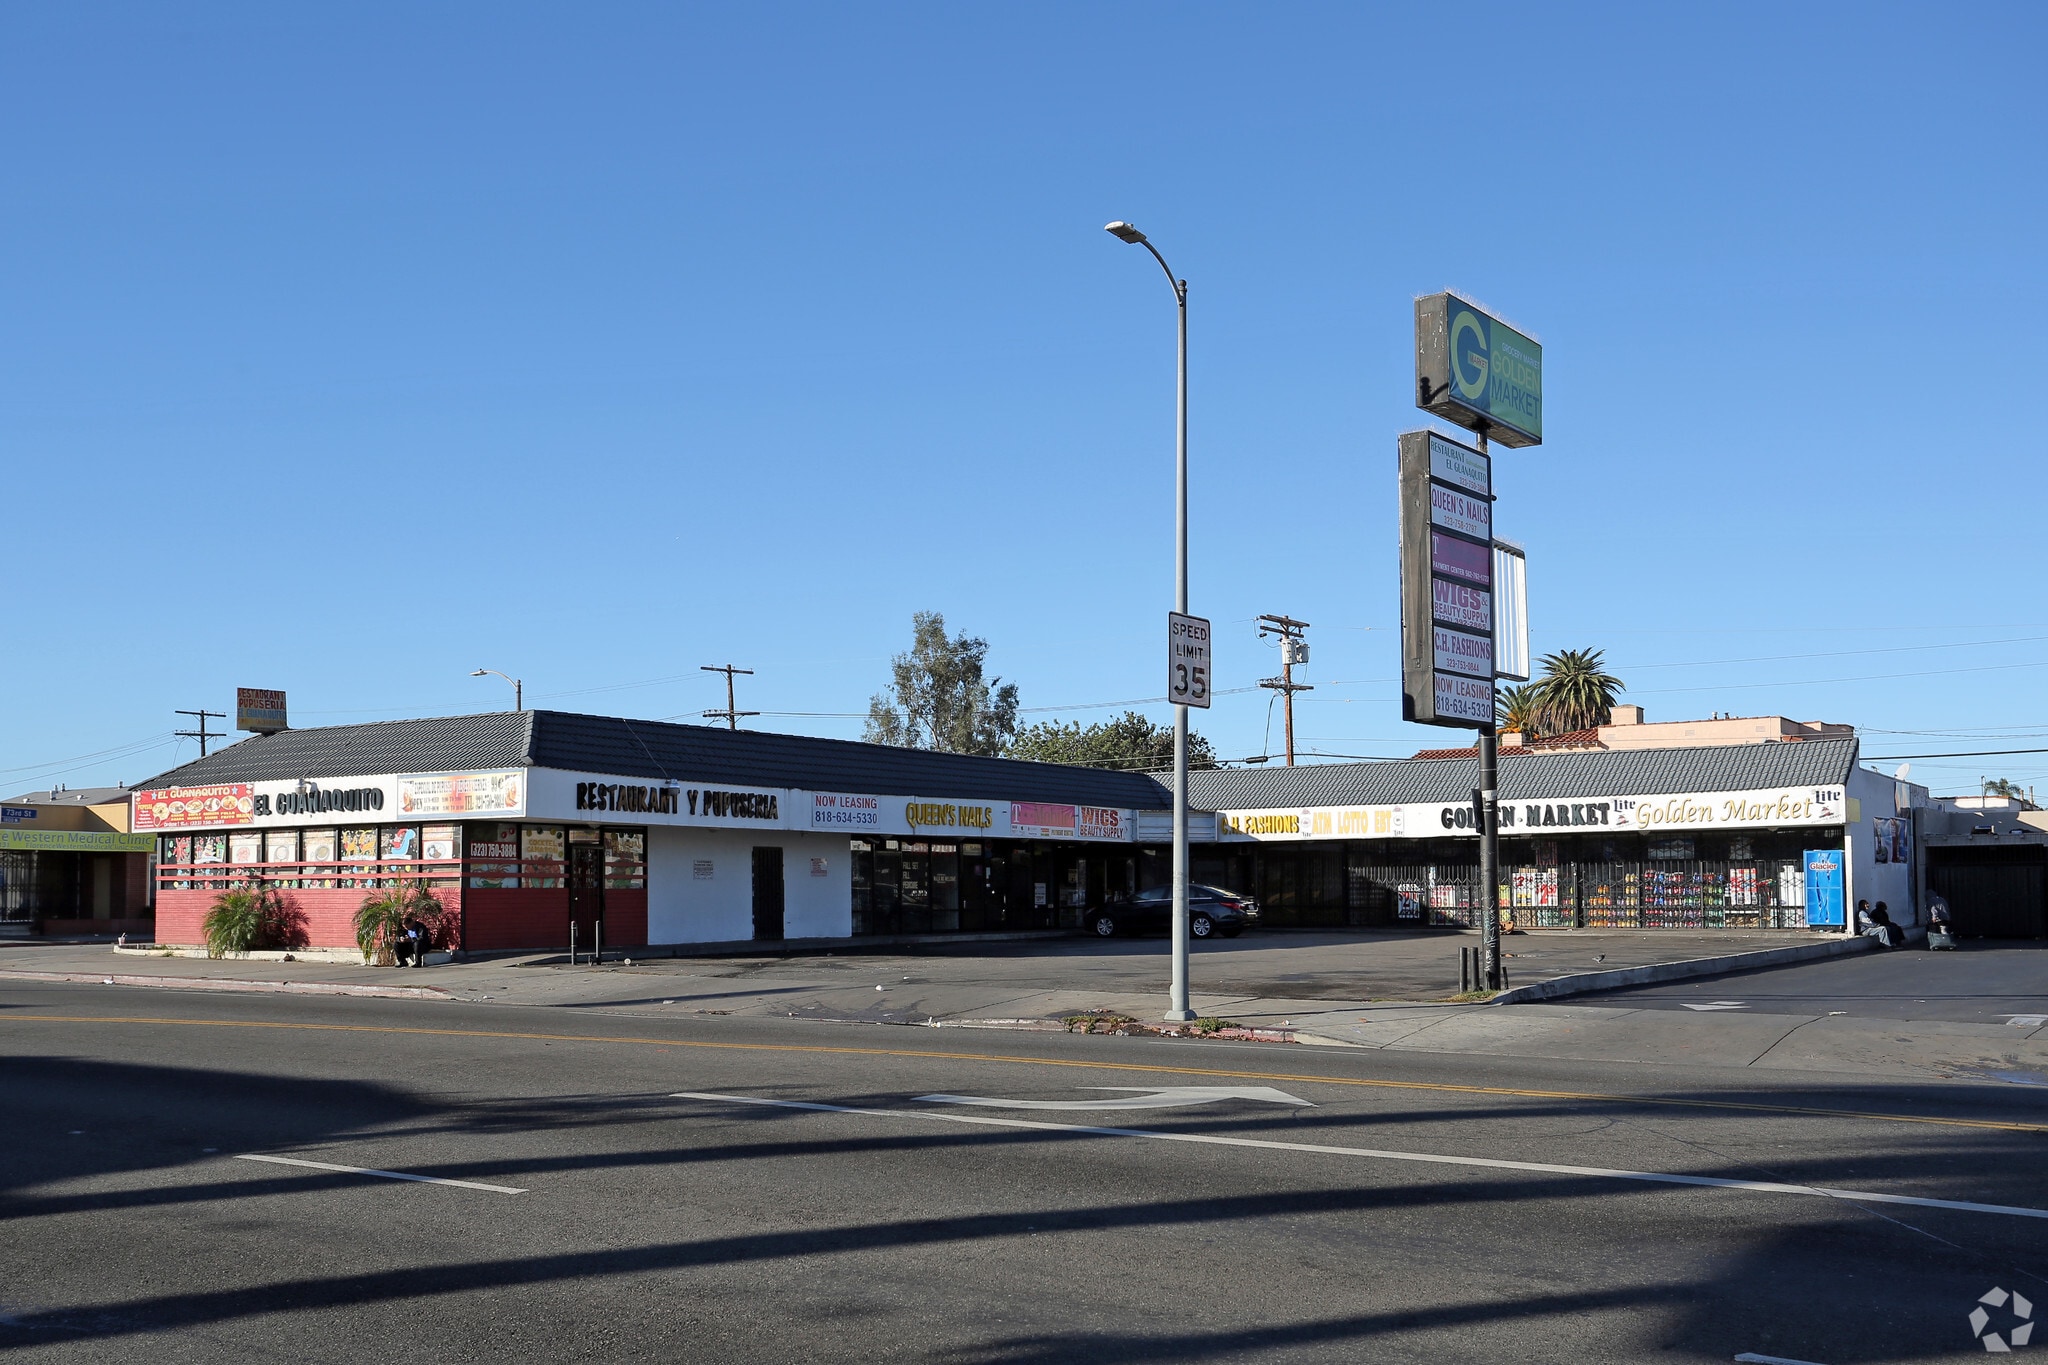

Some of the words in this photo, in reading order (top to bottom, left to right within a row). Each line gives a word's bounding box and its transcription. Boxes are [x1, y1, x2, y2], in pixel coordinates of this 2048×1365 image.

[1492, 350, 1540, 395] GOLDEN
[1491, 375, 1540, 419] MARKET
[1430, 441, 1465, 463] RESTAURANT
[1446, 459, 1453, 470] EL
[1431, 489, 1464, 516] QUEEN'S
[1466, 500, 1488, 524] NAILS
[1432, 535, 1439, 555] T
[1433, 561, 1450, 572] PAYMENT
[1451, 566, 1465, 576] CENTER
[1433, 579, 1481, 610] WIGS
[1481, 596, 1488, 607] &
[1435, 601, 1461, 618] BEAUTY
[1463, 609, 1489, 623] SUPPLY
[1173, 622, 1207, 640] SPEED
[1176, 643, 1204, 660] LIMIT
[1434, 633, 1450, 653] C.H.
[1451, 636, 1491, 660] FASHIONS
[1174, 664, 1206, 699] 35
[1436, 676, 1453, 694] NOW
[1456, 680, 1491, 700] LEASING
[238, 689, 285, 700] RESTAURANT
[238, 699, 286, 709] PUPUSERIA
[1436, 696, 1491, 718] 818-634-5330
[158, 791, 169, 800] EL
[170, 787, 230, 798] GUANAQUITO
[254, 794, 272, 816] EL
[275, 787, 384, 815] GUANAQUITO
[577, 781, 679, 814] RESTAURANT
[687, 790, 698, 815] Y
[703, 790, 779, 819] PUPUSERIA
[815, 795, 836, 807] NOW
[839, 796, 878, 809] LEASING
[1815, 791, 1840, 804] Lite
[6, 809, 22, 817] 73rd
[906, 802, 956, 828] QUEEN'S
[958, 805, 993, 828] NAILS
[1012, 804, 1021, 823] T
[1613, 799, 1635, 812] Lite
[1635, 798, 1714, 829] Golden
[1720, 794, 1813, 821] Market
[815, 810, 878, 824] 818-634-5330
[1081, 807, 1118, 827] WIGS
[1222, 814, 1240, 834] C.H.
[1245, 815, 1299, 834] FASHIONS
[1312, 812, 1333, 834] ATM
[1338, 811, 1369, 834] LOTTO
[1374, 810, 1392, 833] EBT
[1441, 806, 1515, 829] GOLN
[1526, 803, 1610, 827] MARKET
[13, 832, 64, 842] Western
[68, 833, 115, 844] Medical
[118, 834, 151, 845] Clinic
[1080, 825, 1102, 837] BEAUTY
[1103, 826, 1124, 839] SUPPLY
[470, 842, 487, 857] (323)
[487, 843, 517, 857] 750-3884
[1809, 862, 1837, 870] Glacier
